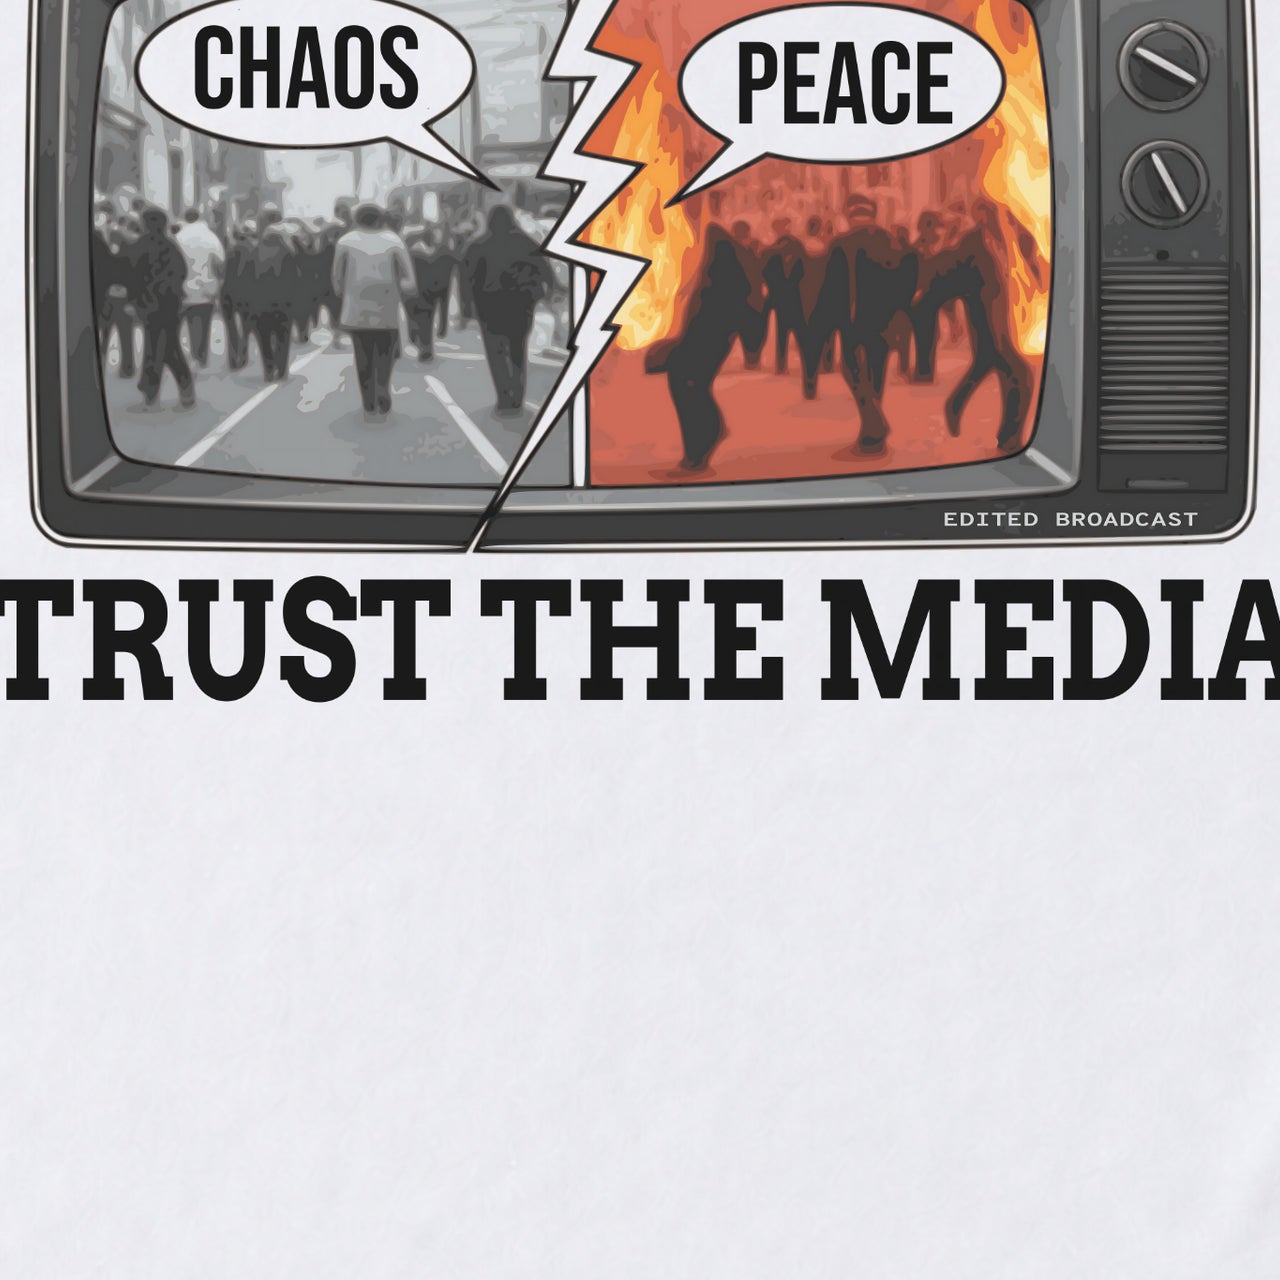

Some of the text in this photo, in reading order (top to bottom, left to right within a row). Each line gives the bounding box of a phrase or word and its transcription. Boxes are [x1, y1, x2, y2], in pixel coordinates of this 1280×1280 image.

[194, 24, 419, 110] CHAOS
[738, 40, 953, 125] PEACE
[944, 512, 1199, 527] EDITED BROADCAST
[481, 578, 783, 701] THE
